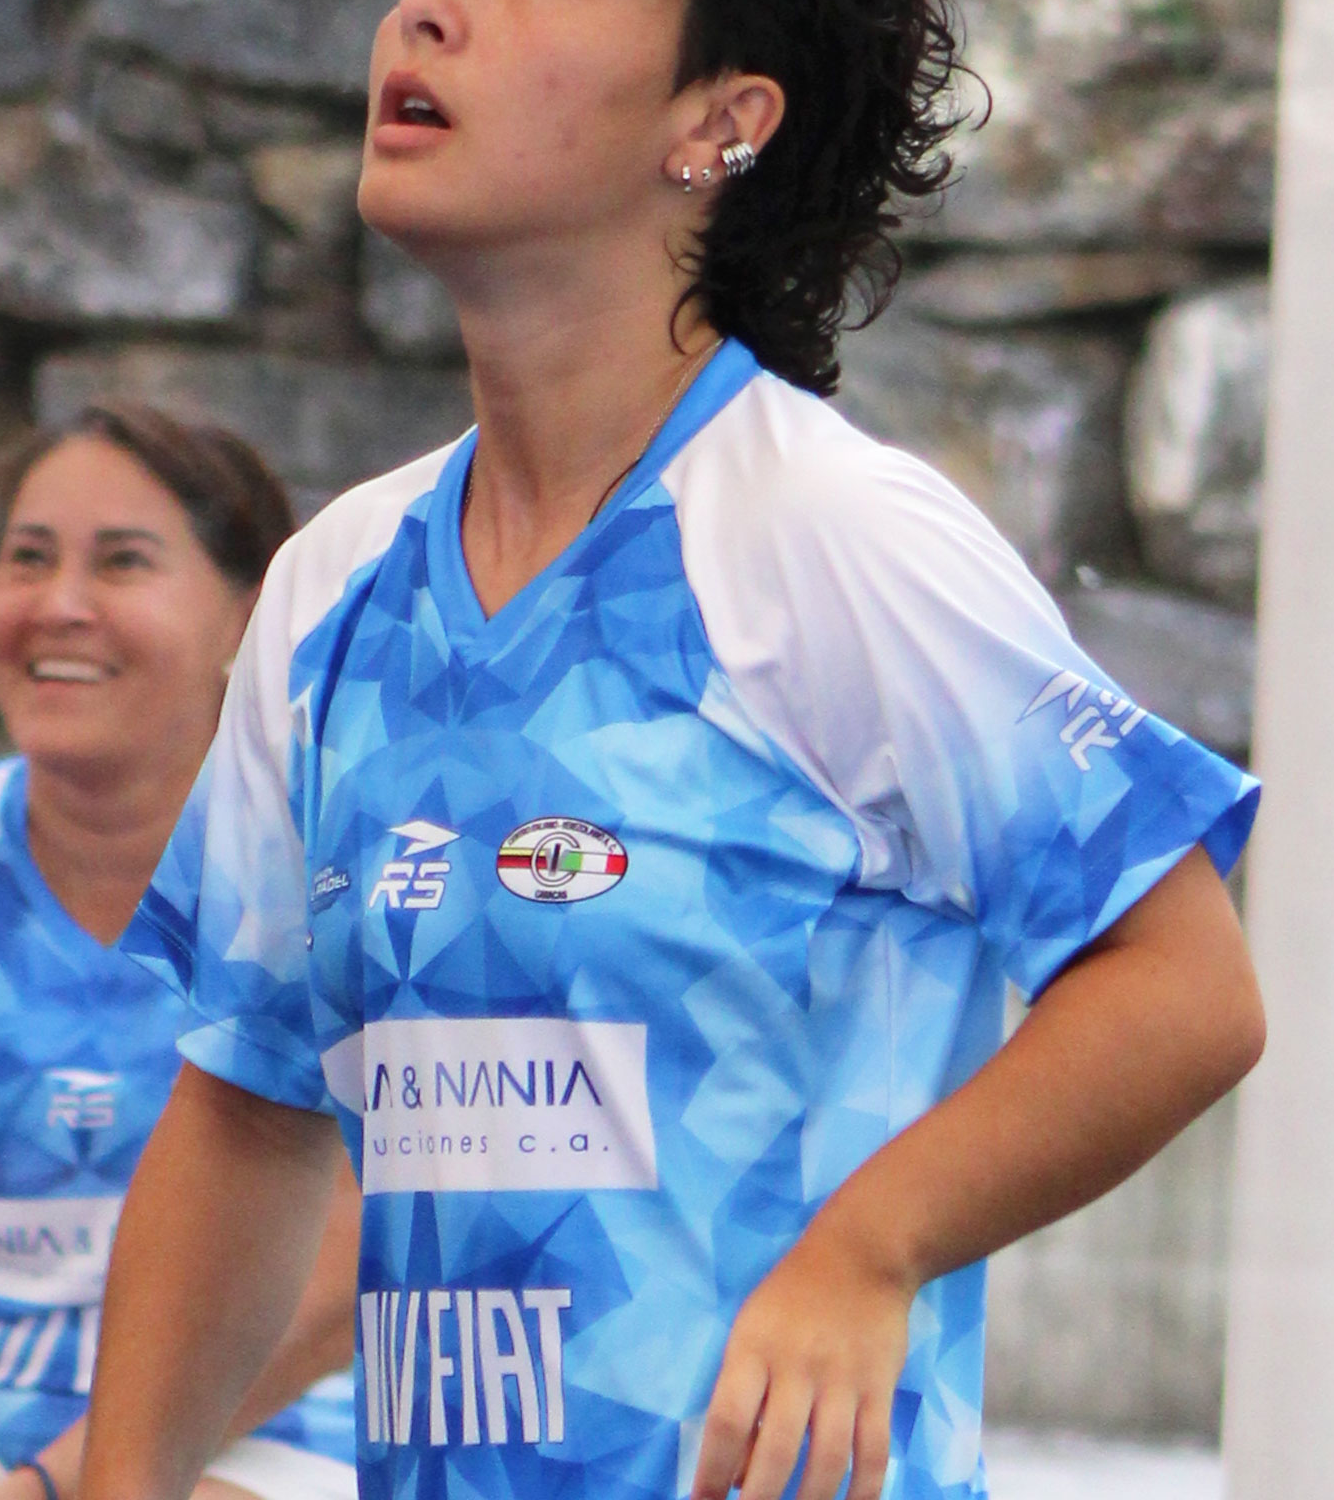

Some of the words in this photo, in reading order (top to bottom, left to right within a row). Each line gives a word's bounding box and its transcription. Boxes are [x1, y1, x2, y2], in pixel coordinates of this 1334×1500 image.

[368, 861, 451, 909] RS
[401, 1065, 423, 1109] &
[435, 1059, 602, 1107] NANIA
[373, 1130, 488, 1156] uciones
